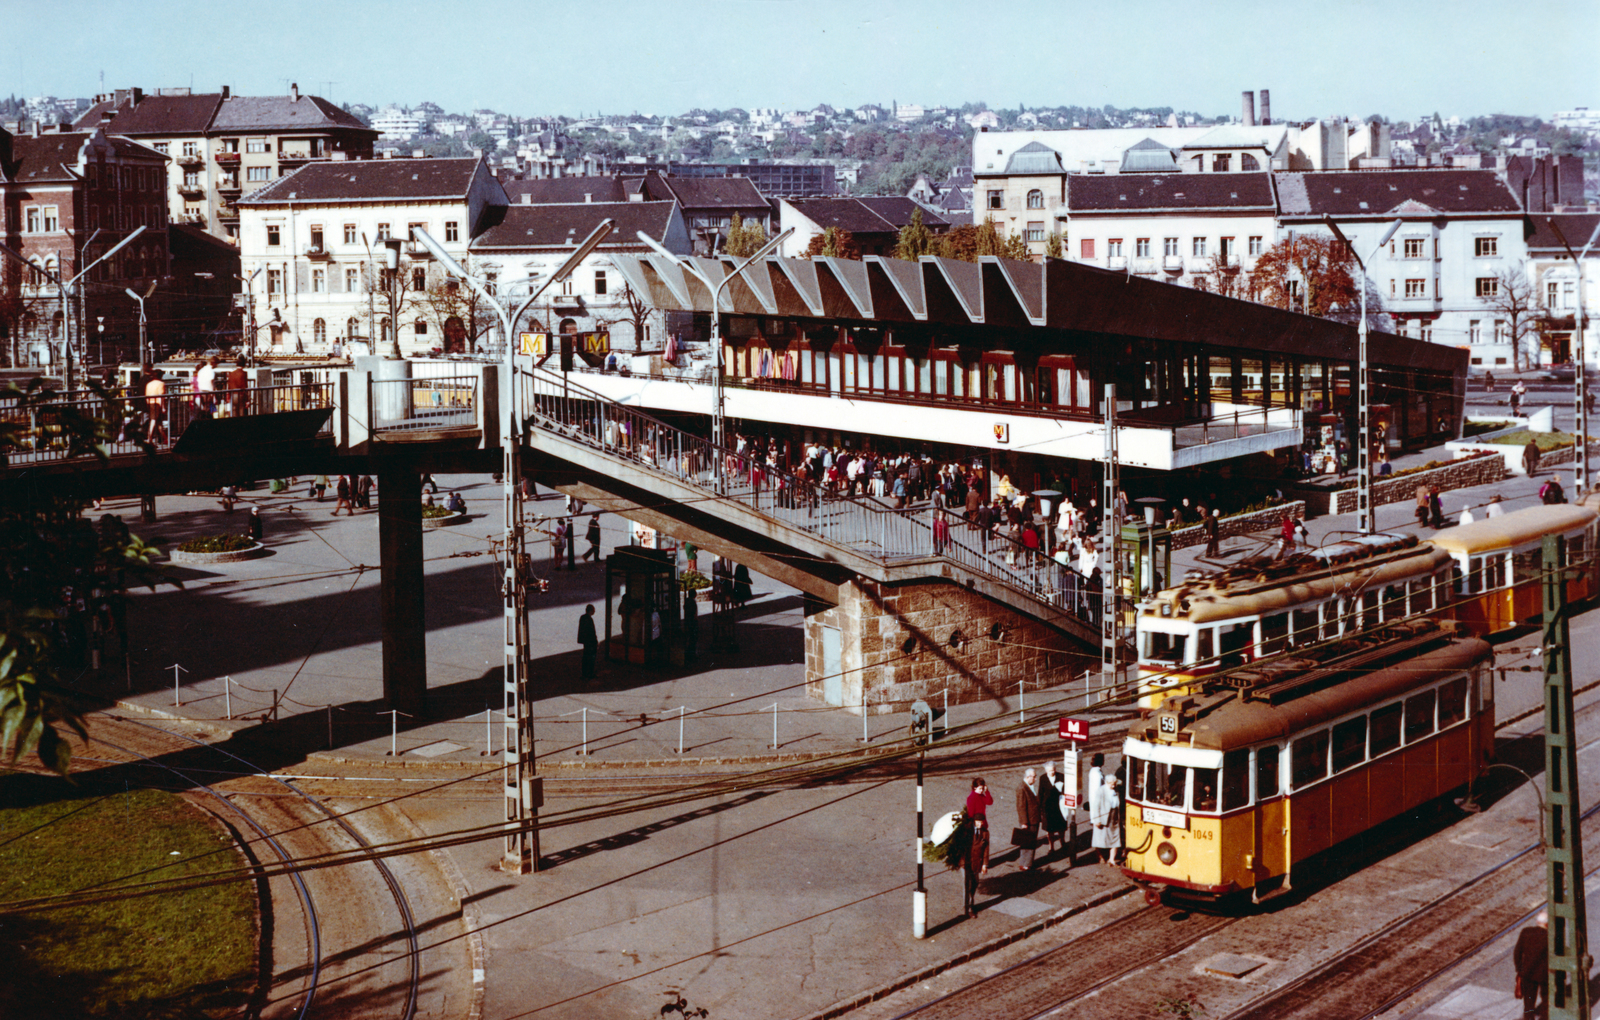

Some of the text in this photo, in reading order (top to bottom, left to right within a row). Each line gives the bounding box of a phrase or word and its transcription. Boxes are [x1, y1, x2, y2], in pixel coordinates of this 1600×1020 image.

[521, 334, 544, 353] M
[585, 334, 608, 353] M
[994, 425, 1004, 435] M
[1068, 721, 1080, 733] M
[1162, 717, 1175, 732] 59
[1193, 830, 1213, 840] 1049
